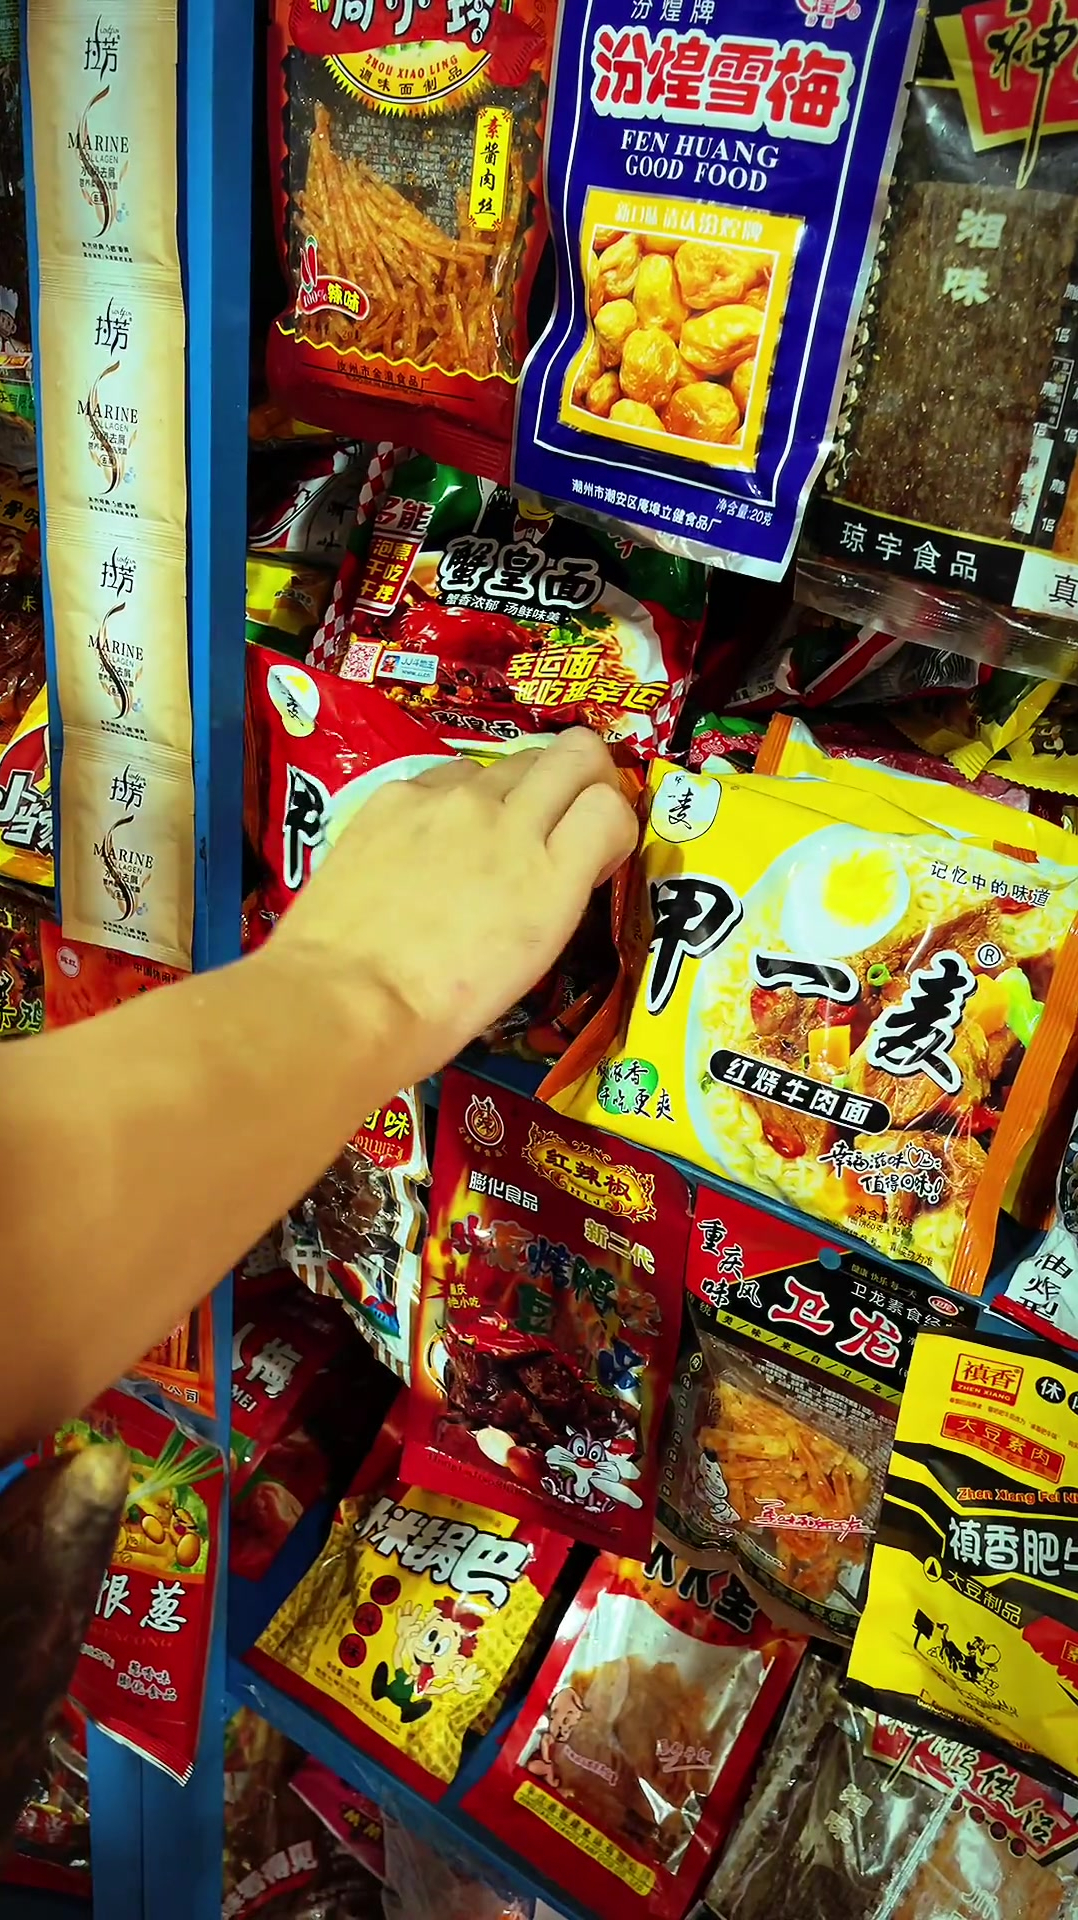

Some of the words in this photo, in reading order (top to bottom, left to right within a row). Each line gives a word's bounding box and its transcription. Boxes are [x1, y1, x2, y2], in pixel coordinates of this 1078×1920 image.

[631, 0, 715, 24] 汾煌牌
[358, 66, 464, 96] 调味面制品
[365, 53, 395, 78] ZHOU
[396, 65, 427, 81] XIAO
[429, 54, 459, 77] LING
[592, 26, 853, 142] 汾煌雪梅
[67, 132, 129, 153] MARINE
[621, 129, 667, 152] FEN
[676, 133, 780, 168] HUANG
[473, 115, 503, 217] 素酱肉丝
[625, 154, 681, 181] GOOD
[695, 161, 768, 193] FOOD
[328, 283, 361, 313] 辣味
[77, 400, 138, 424] MARINE
[373, 539, 413, 562] 泡煮
[840, 520, 979, 583] 琼宇食品
[366, 558, 405, 582] 干吃
[440, 535, 601, 609] 蟹皇面
[503, 602, 562, 623] 汤鲜味美
[88, 634, 143, 661] MARINE
[506, 645, 604, 681] 幸运面
[512, 680, 669, 711] 越吃越幸运
[93, 842, 154, 869] MARINE
[931, 861, 1050, 907] 记忆中的味道
[597, 1087, 675, 1122] 干吃更爽
[724, 1057, 872, 1125] 红烧牛肉面
[469, 1170, 539, 1212] 膨化食品
[545, 1149, 632, 1203] 红辣椒
[584, 1218, 655, 1275] 新二代
[768, 1276, 903, 1368] 卫龙
[850, 1280, 953, 1328] 卫龙素食经
[957, 1384, 981, 1395] ZHEN
[983, 1389, 1011, 1402] XIANG
[957, 1418, 1050, 1467] 大豆素肉
[957, 1487, 992, 1501] Zhen
[995, 1489, 1035, 1505] Xiang
[1038, 1489, 1061, 1504] Fei
[947, 1570, 1023, 1625] 大豆制品
